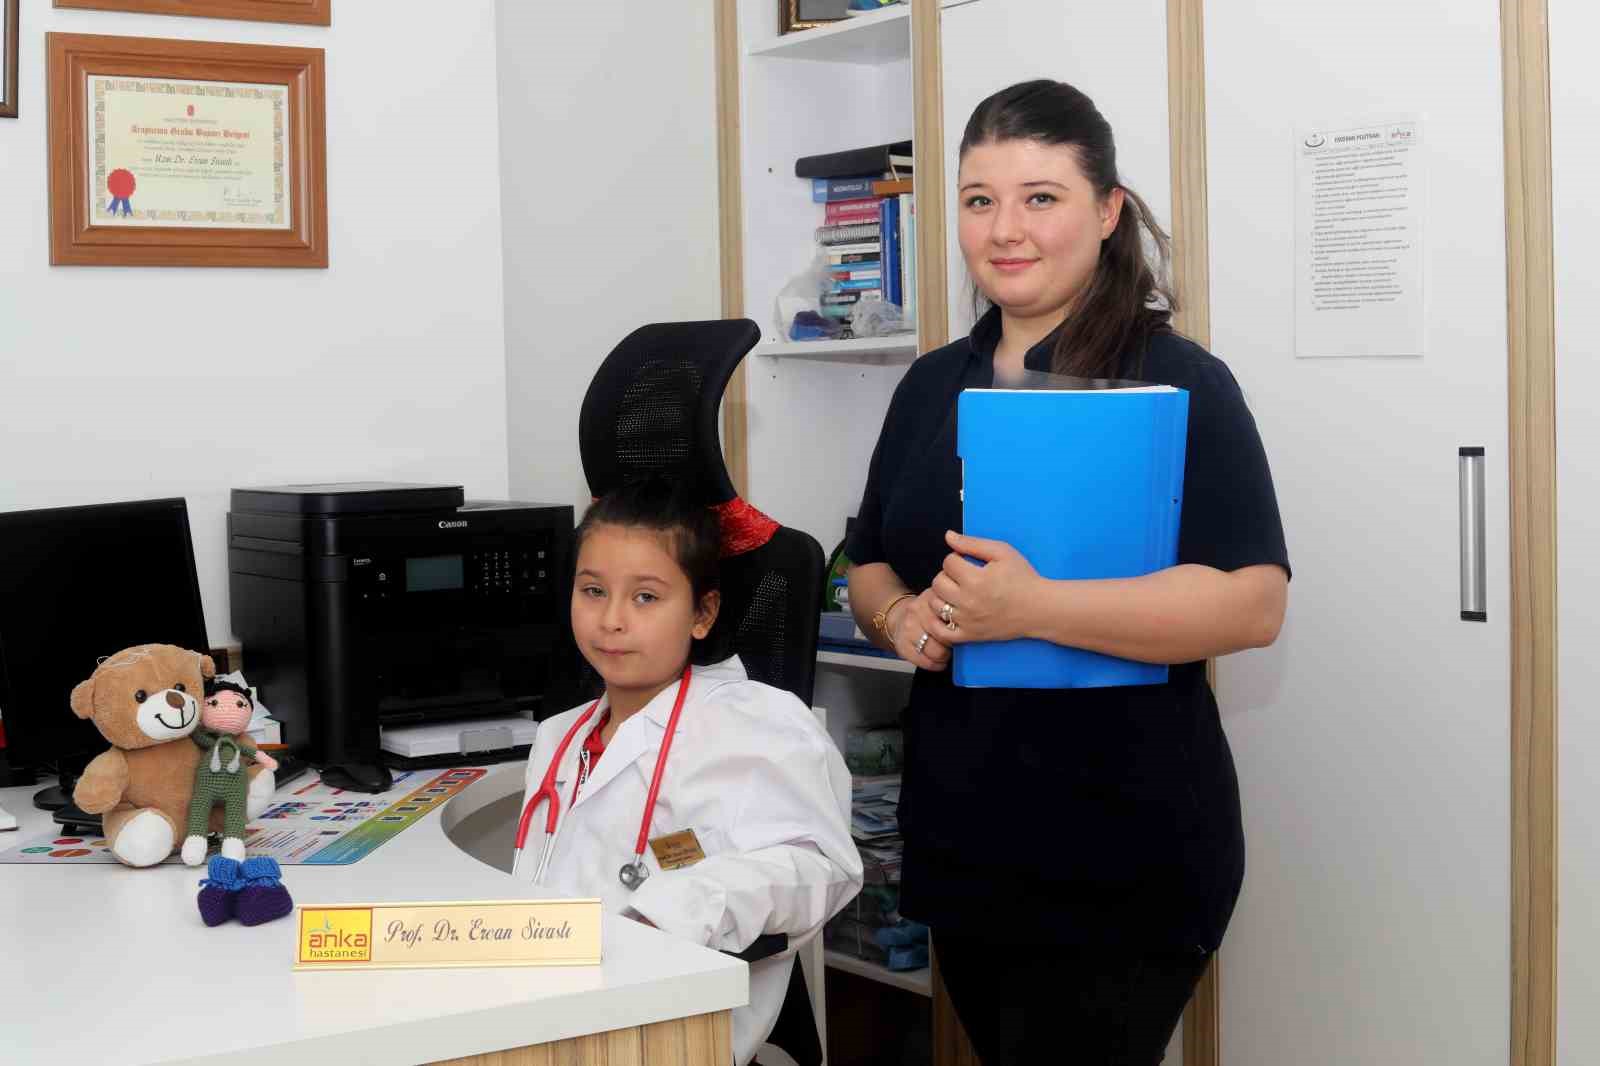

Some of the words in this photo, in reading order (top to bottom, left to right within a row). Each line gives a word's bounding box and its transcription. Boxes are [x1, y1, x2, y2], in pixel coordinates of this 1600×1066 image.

[438, 520, 468, 529] Canon
[309, 928, 368, 948] anka
[384, 918, 424, 949] Prof.
[432, 917, 459, 942] Dr.
[468, 917, 513, 941] Ercan
[310, 948, 367, 959] hastanesi
